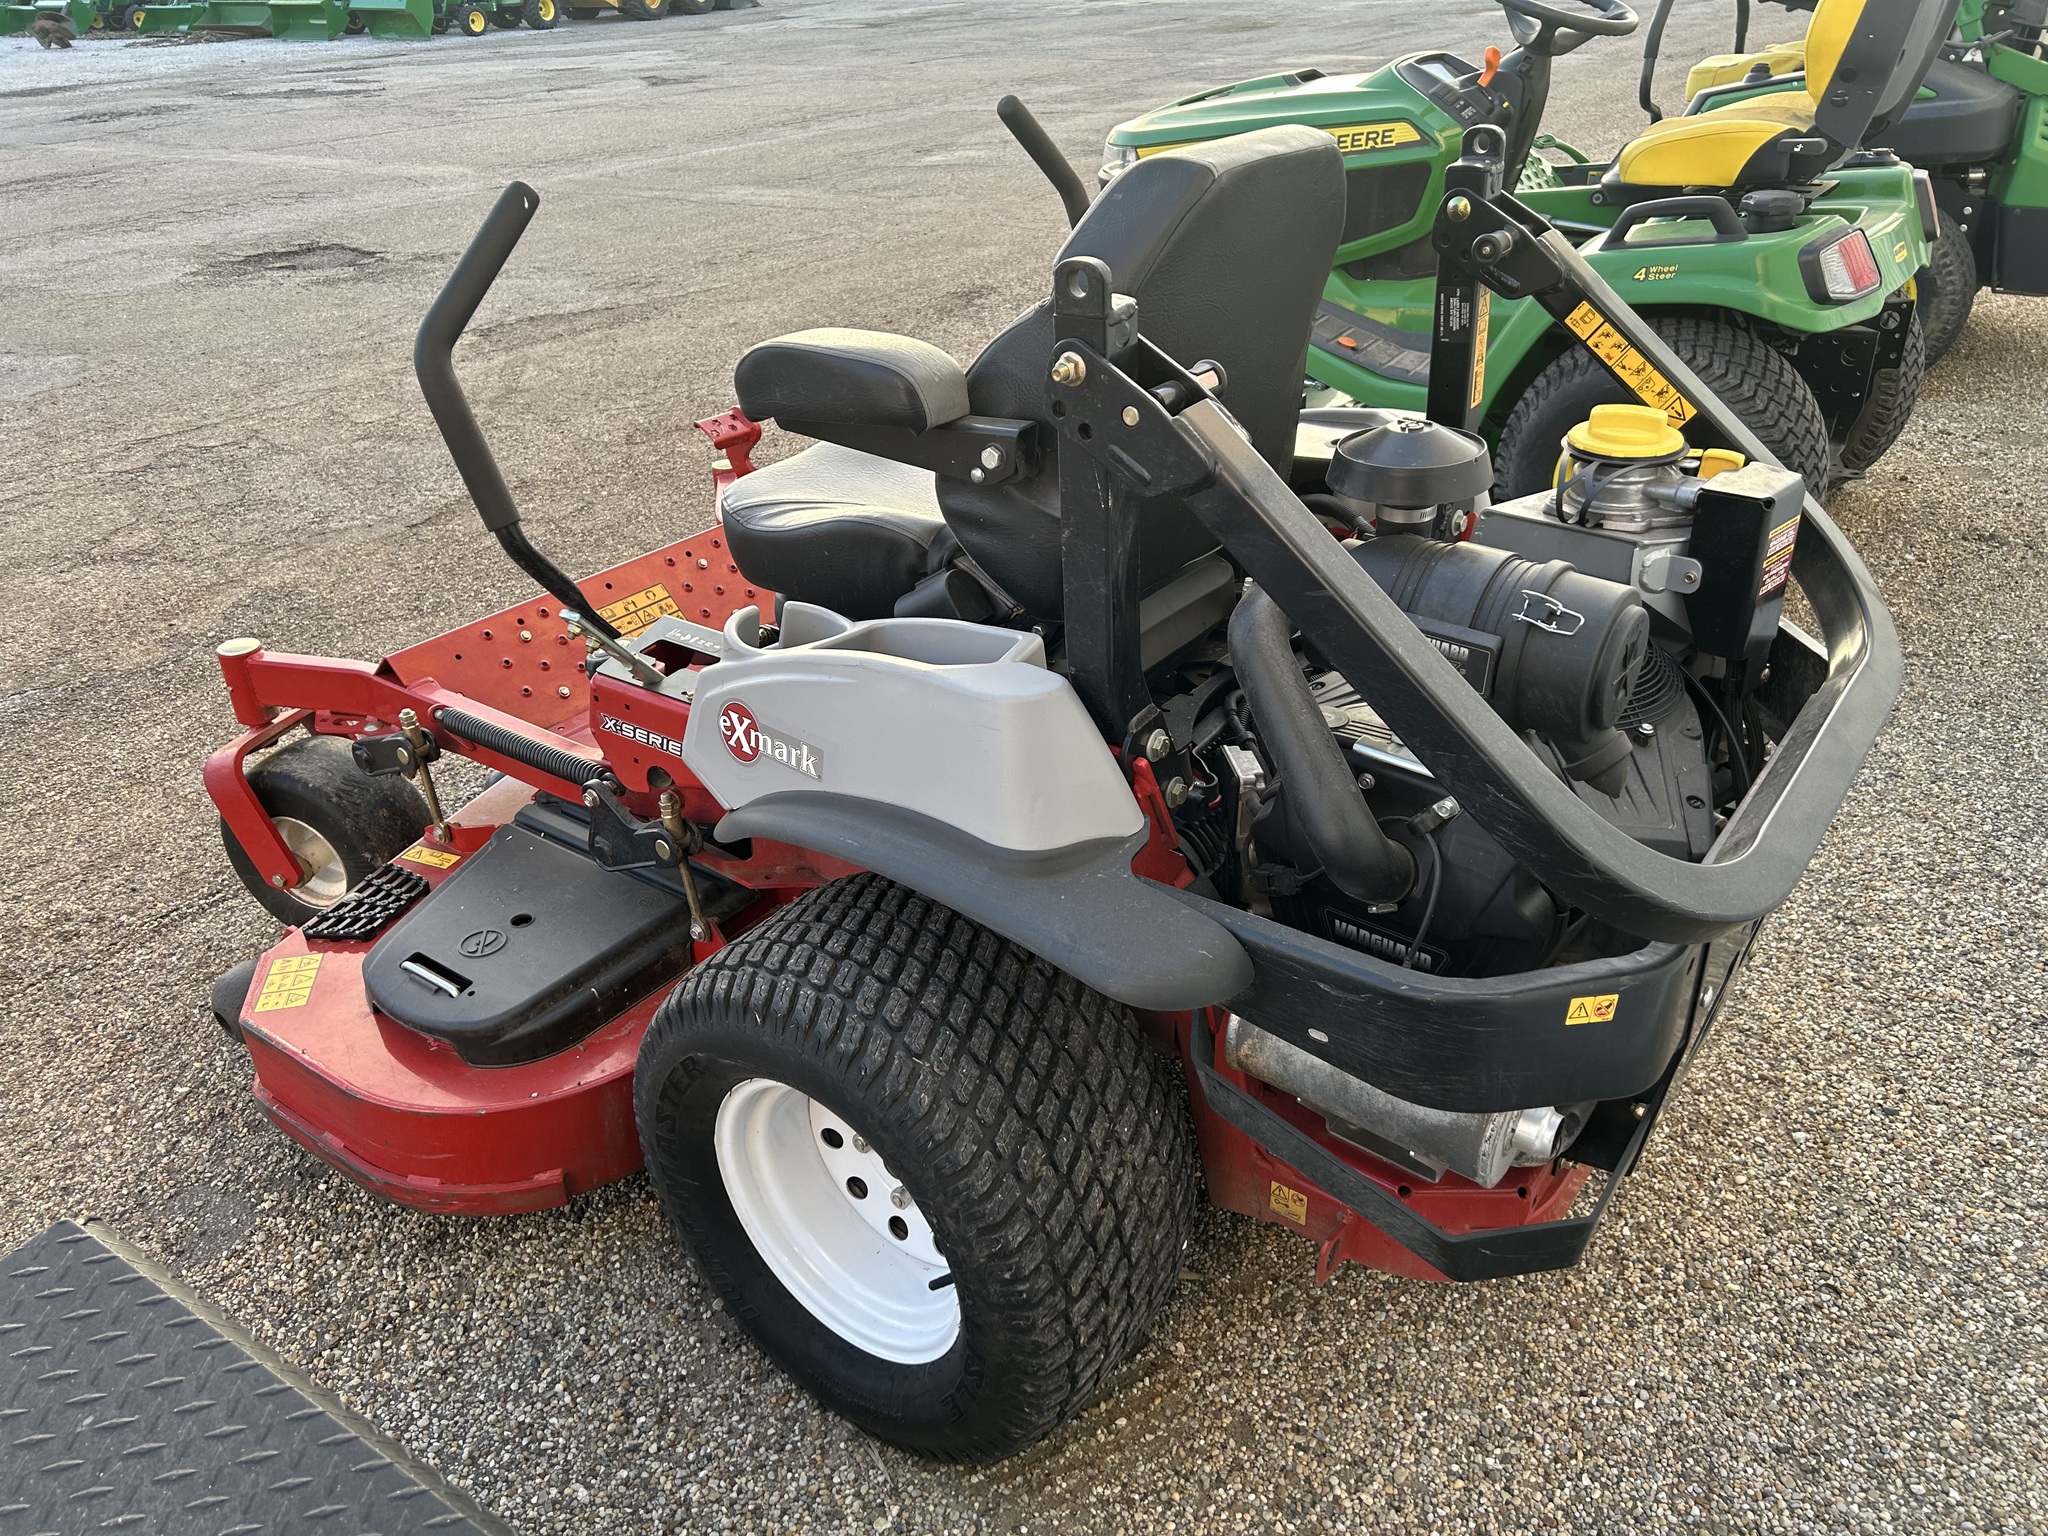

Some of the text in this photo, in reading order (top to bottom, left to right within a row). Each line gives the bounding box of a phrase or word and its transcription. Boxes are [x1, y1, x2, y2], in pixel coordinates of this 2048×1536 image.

[1335, 128, 1396, 150] EERE
[1633, 264, 1679, 281] 4 Wheel
[1647, 272, 1676, 281] Steer
[601, 714, 682, 757] X-SERIE
